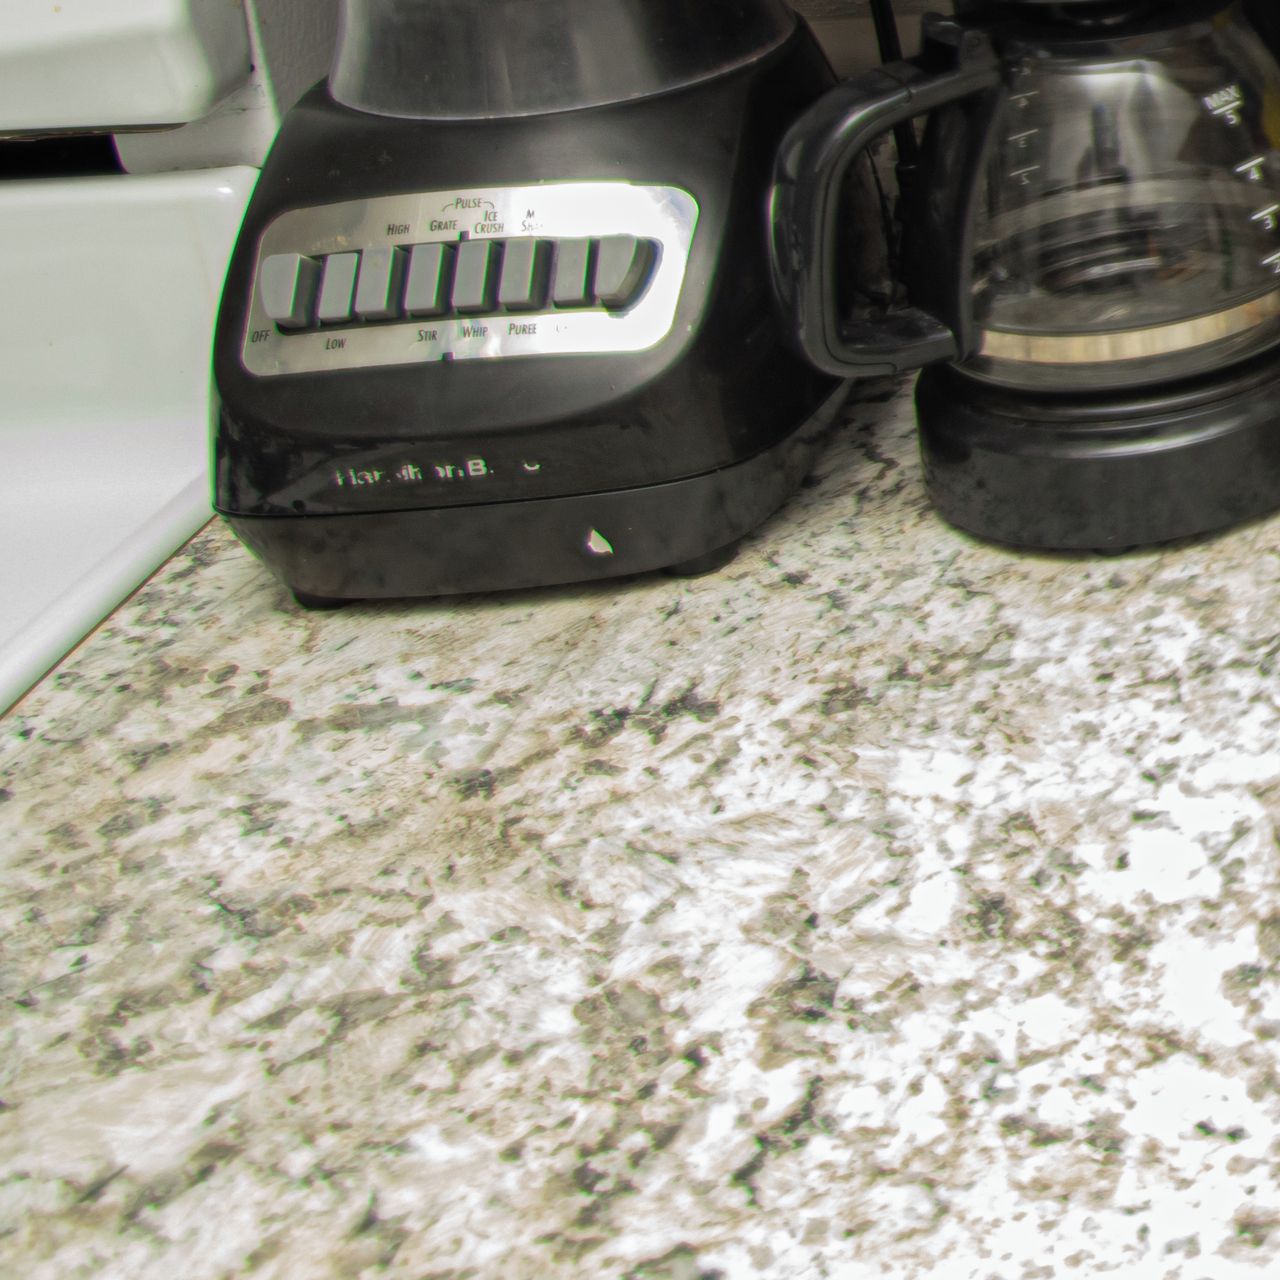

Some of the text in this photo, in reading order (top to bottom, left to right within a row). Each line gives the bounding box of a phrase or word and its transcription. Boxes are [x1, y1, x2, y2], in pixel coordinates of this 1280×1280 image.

[1203, 84, 1241, 109] MAX
[1225, 109, 1238, 125] 5
[1248, 166, 1261, 180] 4
[455, 197, 483, 209] PULSE
[484, 210, 498, 222] ICE
[1263, 214, 1274, 230] 3
[387, 223, 410, 235] HIGH
[430, 219, 457, 232] GRATE
[474, 222, 504, 234] CRUSH
[417, 329, 438, 342] STIR
[462, 325, 488, 338] WHIP
[508, 323, 537, 335] PUREE
[251, 330, 271, 343] OFF
[326, 338, 347, 351] LOW
